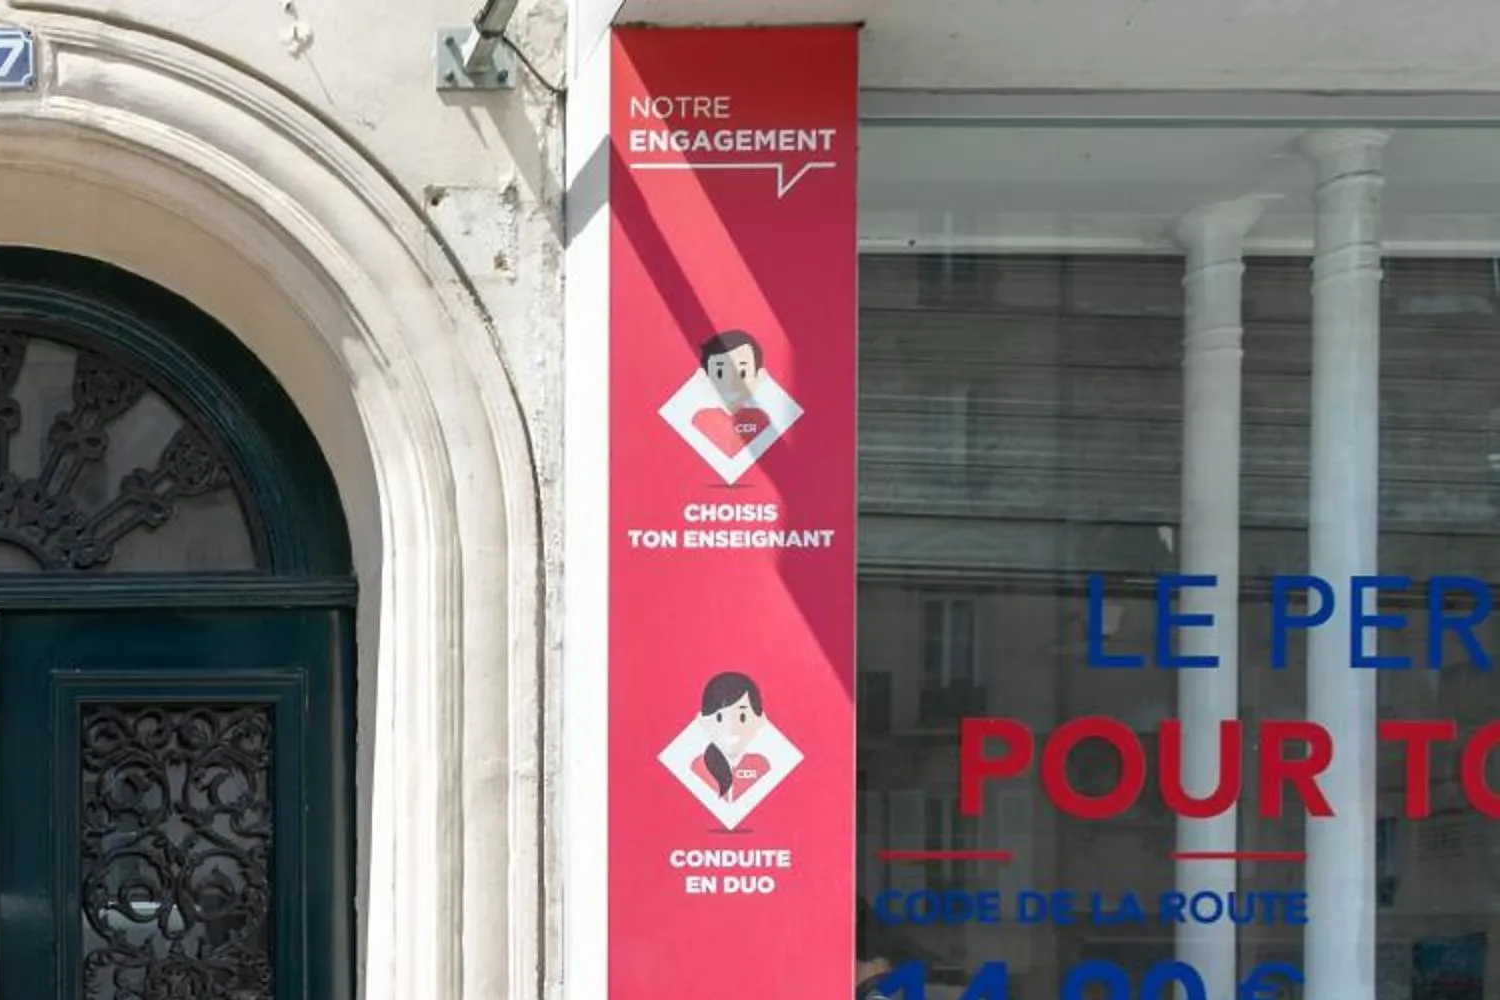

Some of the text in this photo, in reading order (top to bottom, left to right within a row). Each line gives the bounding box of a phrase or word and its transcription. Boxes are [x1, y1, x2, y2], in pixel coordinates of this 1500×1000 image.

[630, 96, 730, 118] NOTRE
[629, 129, 835, 153] ENGAGEMENT
[684, 504, 777, 522] CHOISIS
[628, 530, 833, 548] TON ENSEIGNANT
[1086, 574, 1493, 671] LE PER
[959, 716, 1335, 818] POUR
[670, 850, 790, 868] CONDUITE
[686, 876, 775, 893] EN DUO
[875, 889, 1308, 925] CODE DE LA ROUTE
